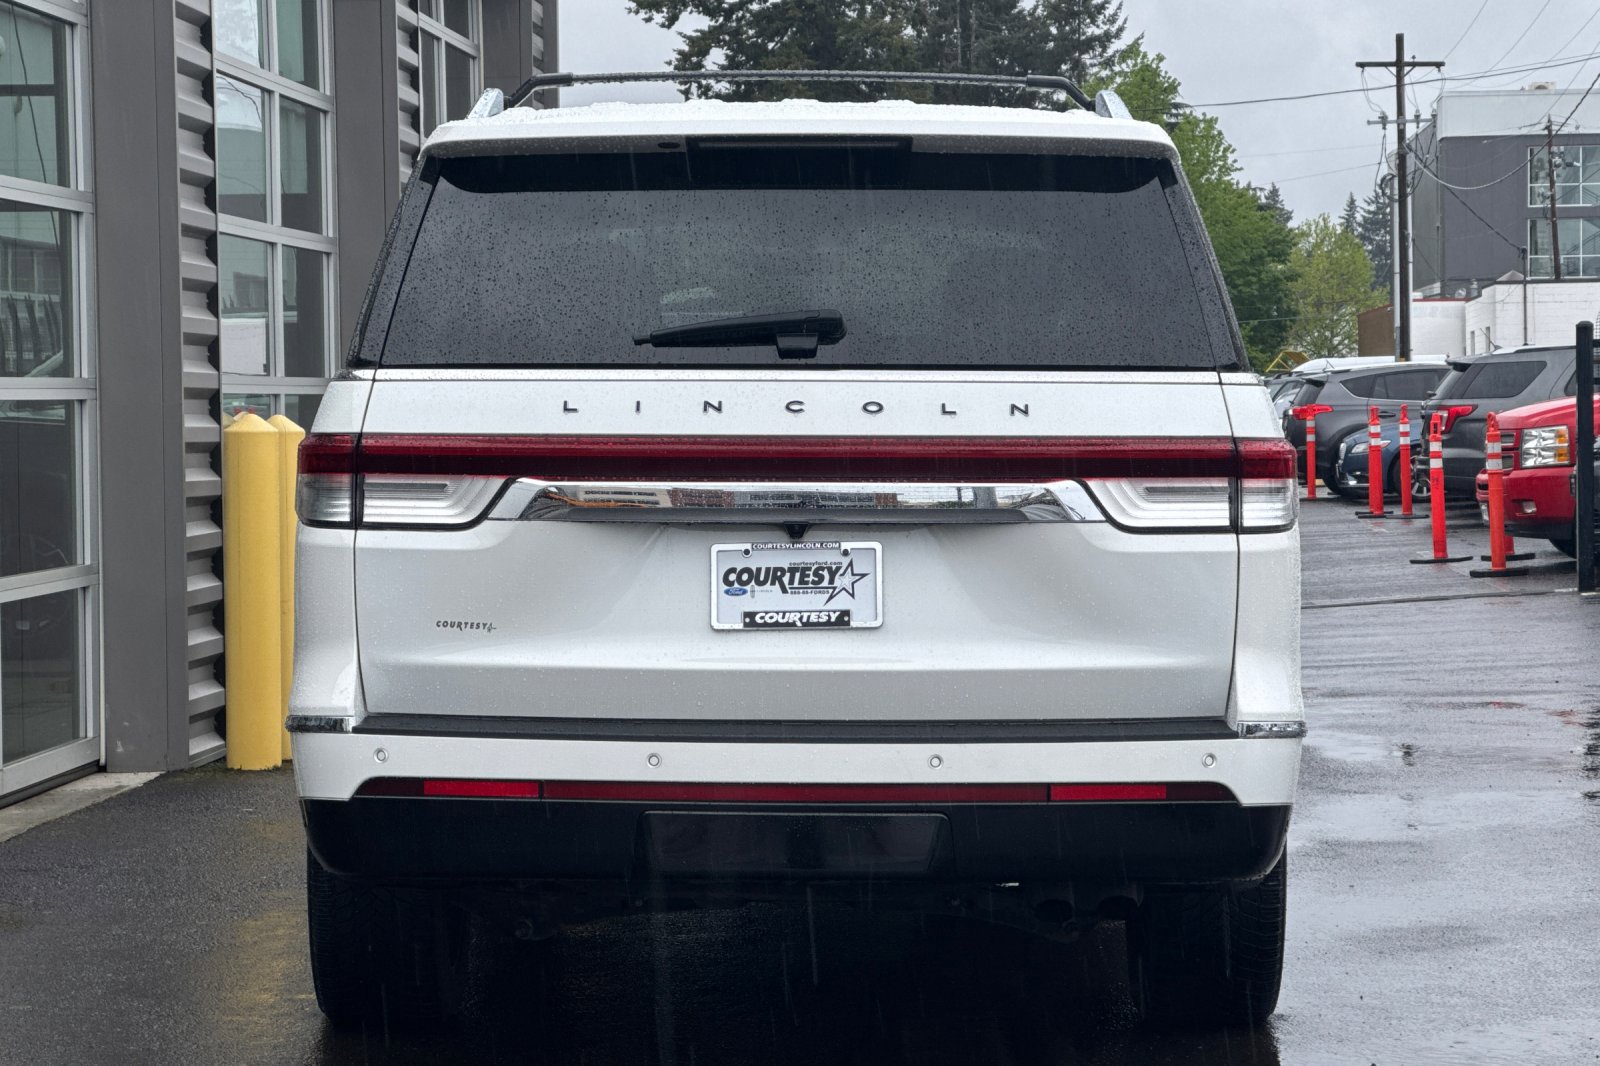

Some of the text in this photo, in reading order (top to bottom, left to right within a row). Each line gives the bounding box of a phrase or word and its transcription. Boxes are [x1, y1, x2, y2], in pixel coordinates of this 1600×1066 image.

[563, 400, 1028, 416] LINCOLN
[752, 542, 840, 550] COURTESYLINCOLN.COM
[722, 566, 843, 594] COURTESY
[436, 620, 488, 631] COURTESY
[754, 611, 840, 626] COURTESY
